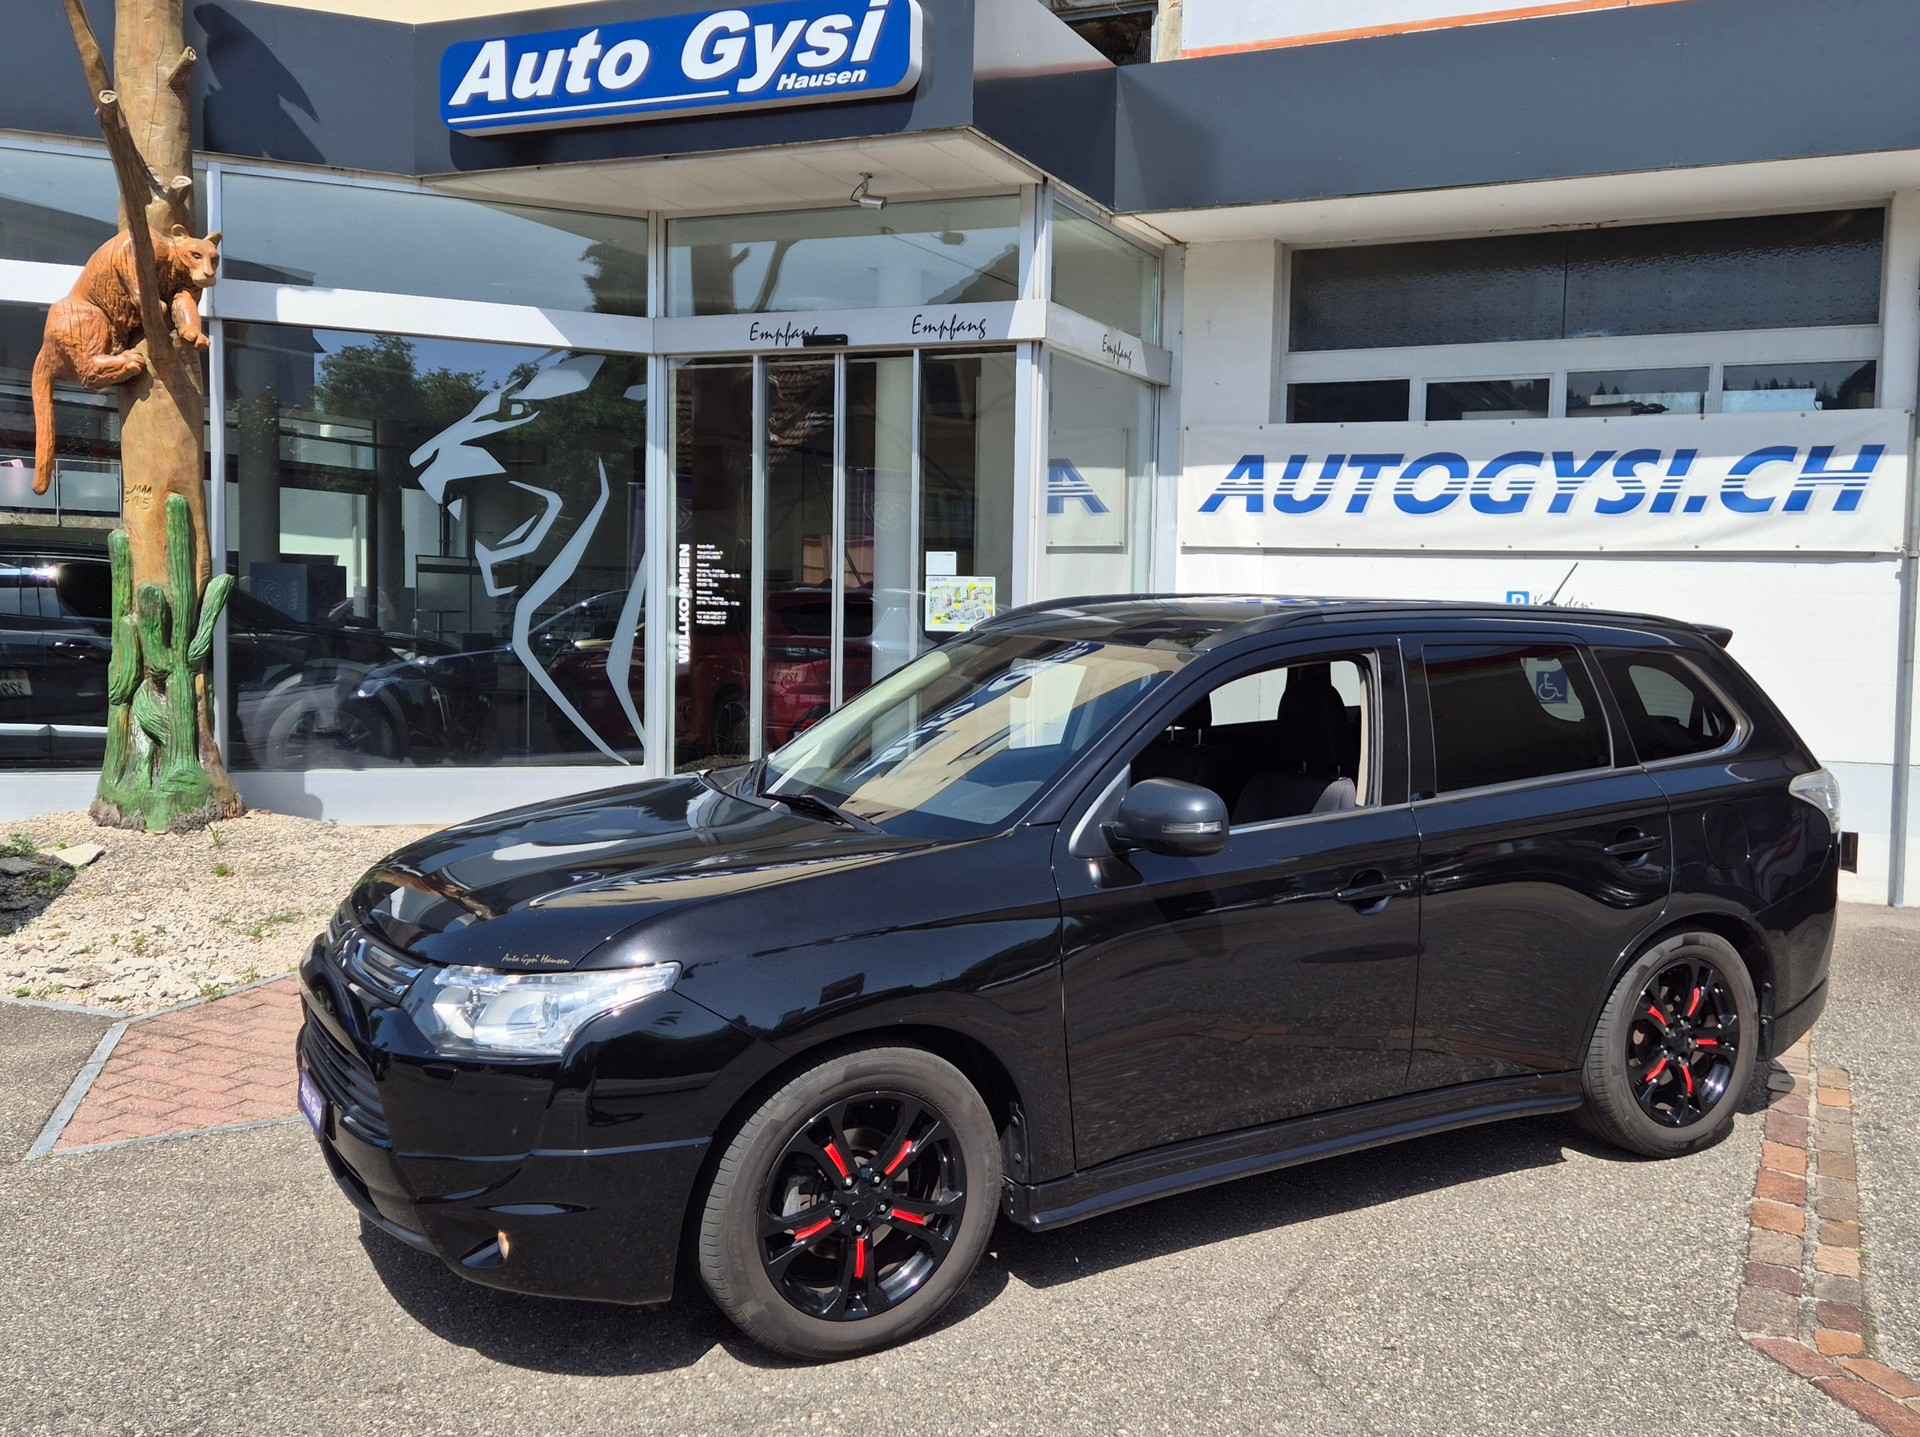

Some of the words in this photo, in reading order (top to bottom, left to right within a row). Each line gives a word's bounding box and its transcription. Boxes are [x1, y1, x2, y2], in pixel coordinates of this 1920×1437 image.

[448, 28, 650, 106] Auto
[680, 0, 891, 92] Gysi
[776, 68, 867, 92] Hausen
[911, 313, 987, 339] Empfang
[1102, 333, 1132, 369] Empfang
[1197, 443, 1888, 516] AUTOGYSI.CH
[679, 543, 690, 664] WILLKOMMEN
[501, 952, 520, 962] Auto
[540, 954, 570, 965] Hausen
